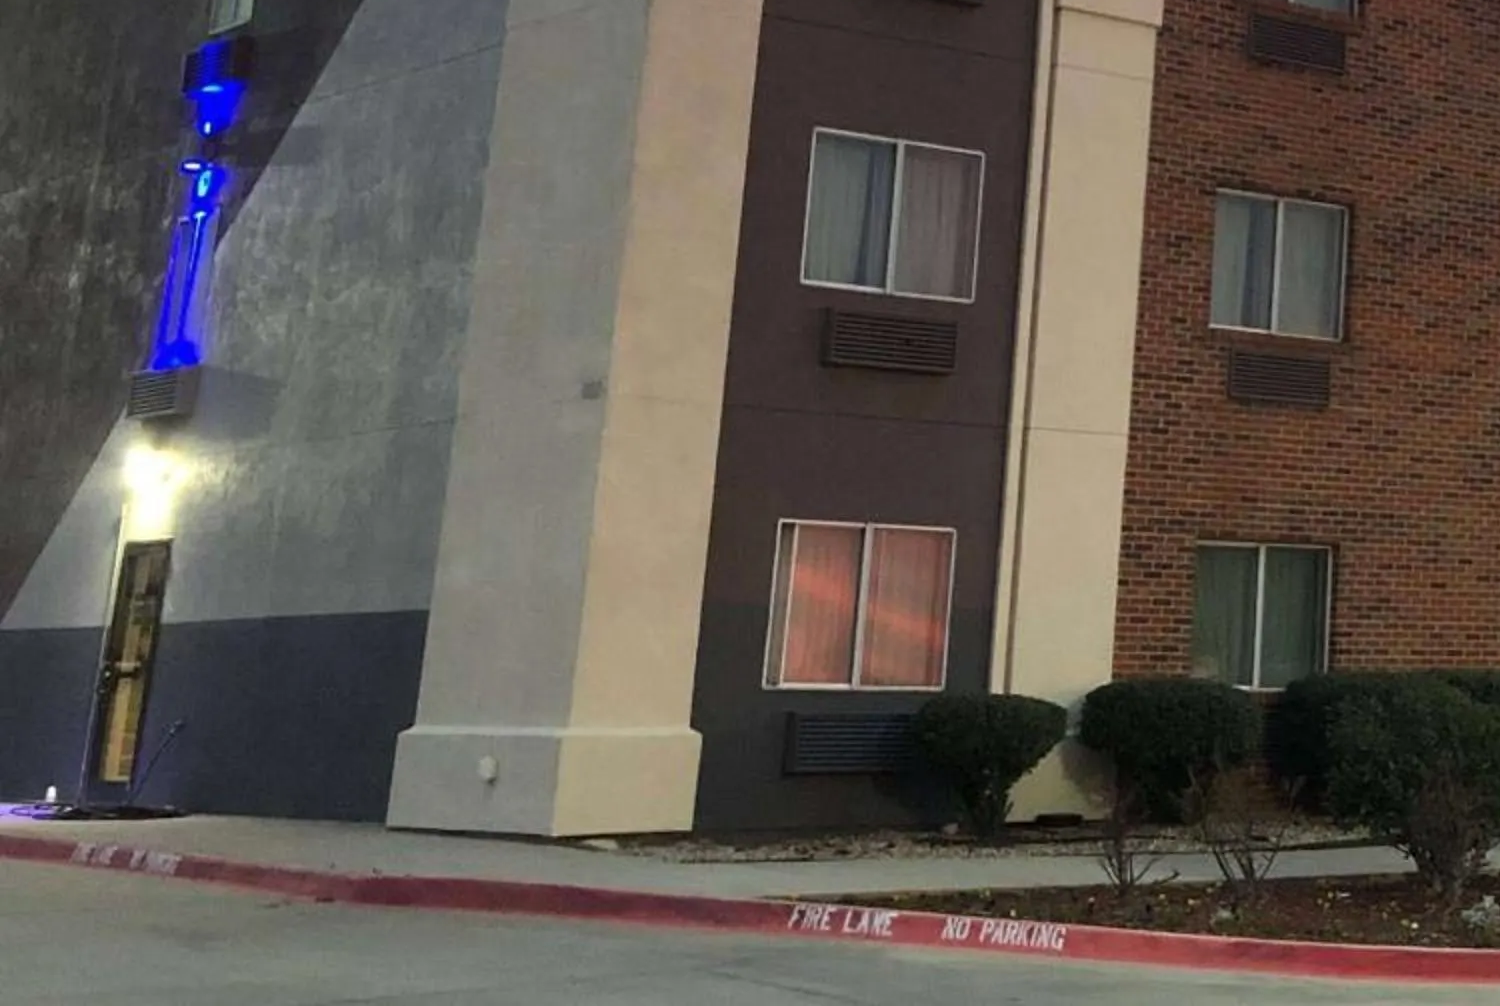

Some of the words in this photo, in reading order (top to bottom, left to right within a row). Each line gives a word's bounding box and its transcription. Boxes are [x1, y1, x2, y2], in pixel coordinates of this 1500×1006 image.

[787, 904, 836, 931] FIRE
[843, 907, 898, 937] LANE
[940, 917, 971, 940] NO
[979, 921, 1067, 951] PARKING
